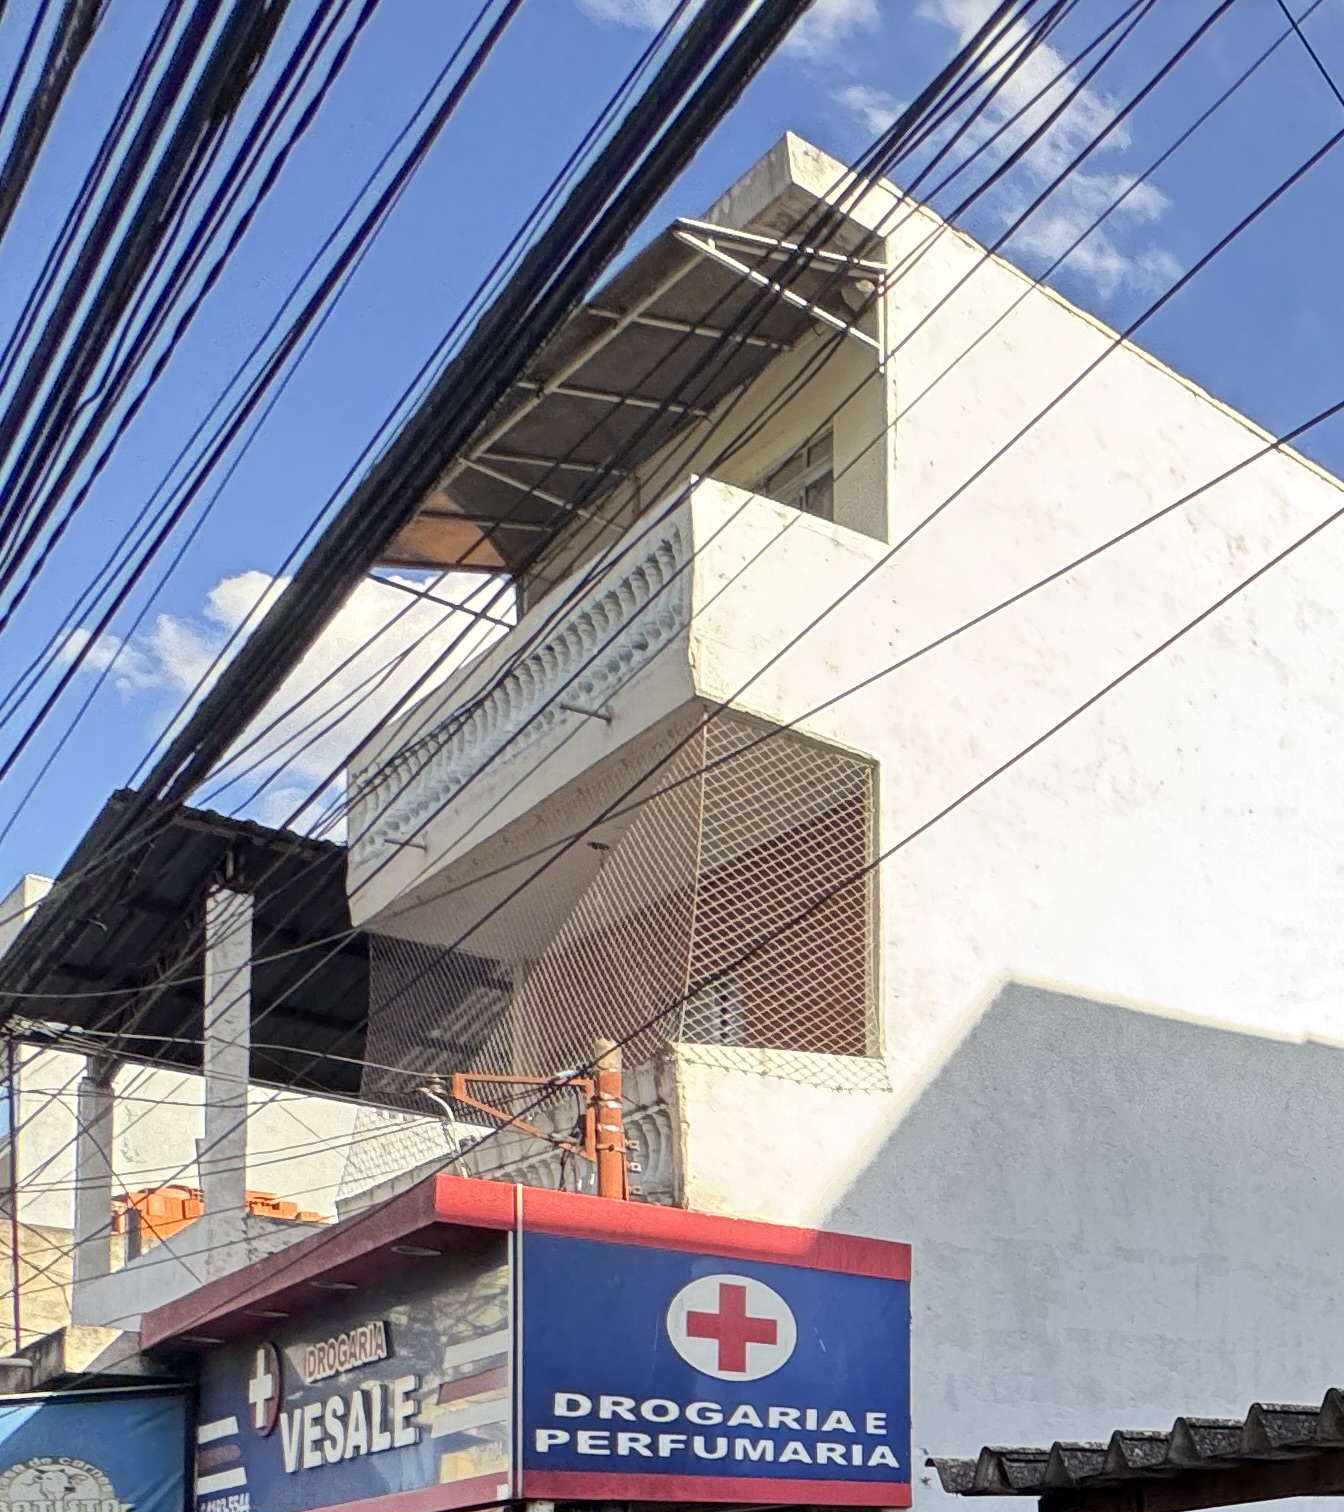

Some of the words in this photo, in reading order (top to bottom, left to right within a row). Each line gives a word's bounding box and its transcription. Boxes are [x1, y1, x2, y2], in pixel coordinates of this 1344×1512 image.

[304, 1321, 388, 1384] DROGARIA
[280, 1374, 419, 1474] VESALE
[552, 1392, 855, 1433] DROGARIA
[865, 1412, 888, 1435] E
[535, 1428, 900, 1468] PERFUMARIA
